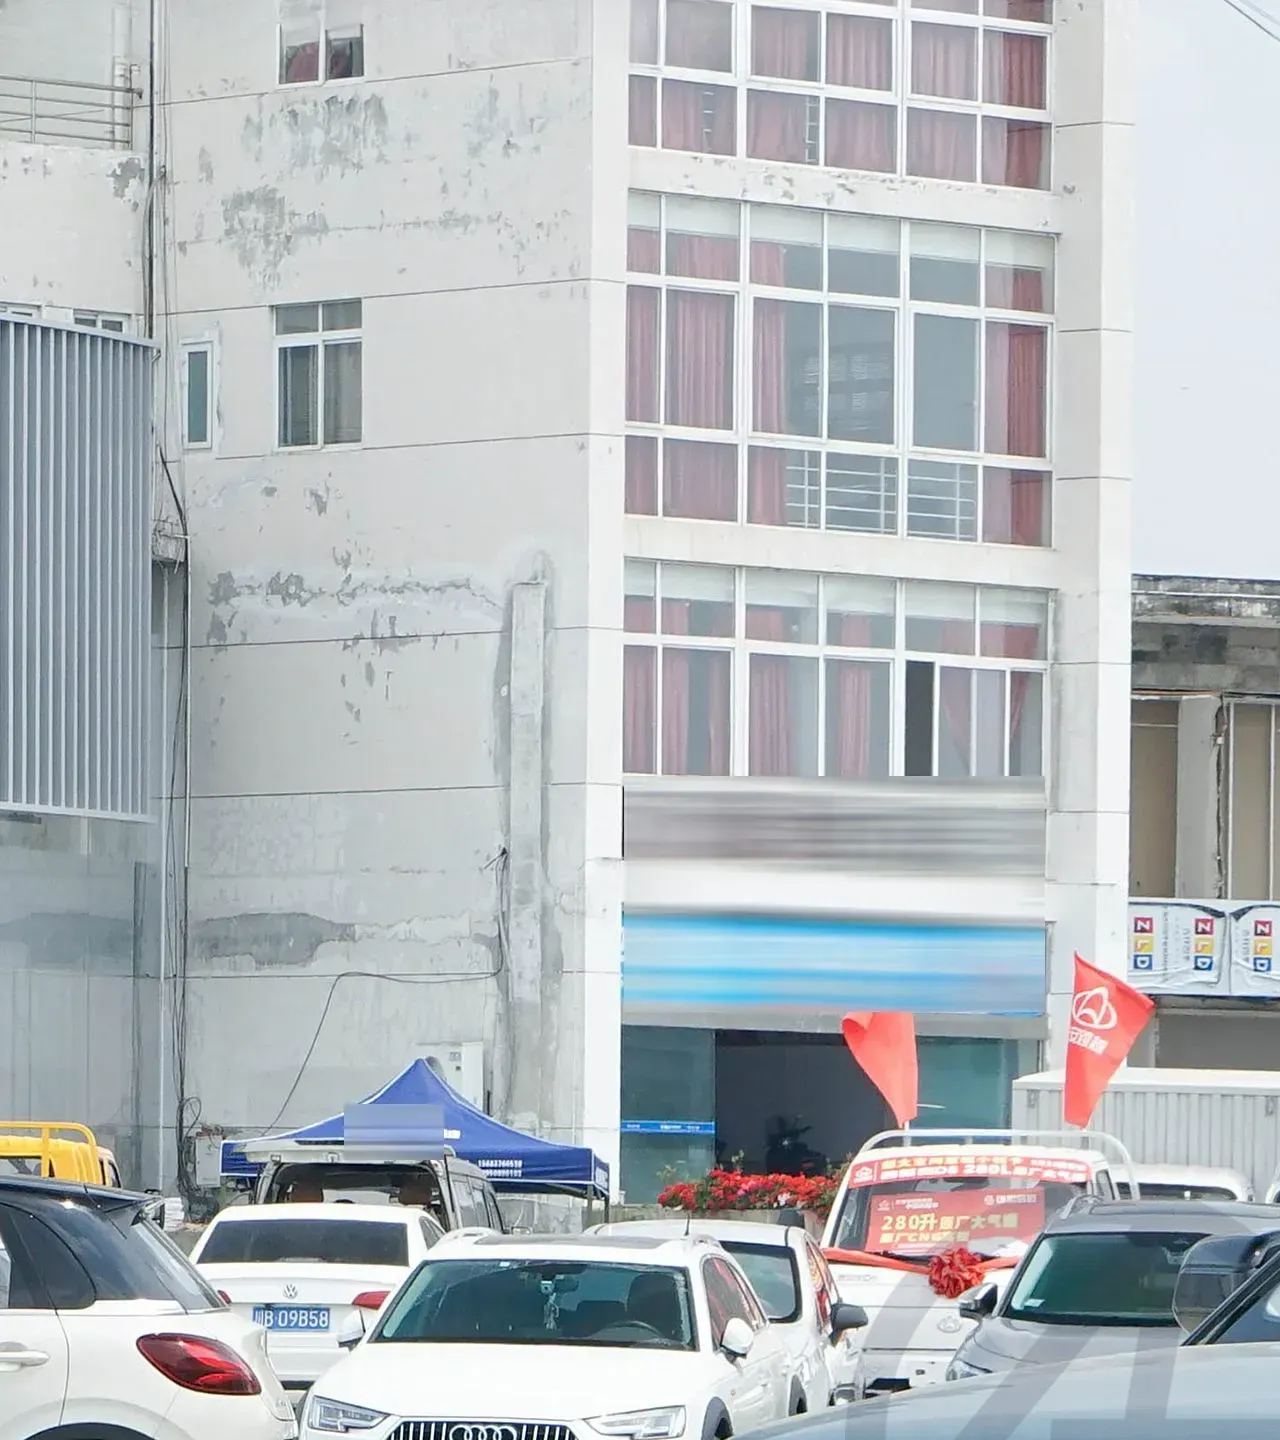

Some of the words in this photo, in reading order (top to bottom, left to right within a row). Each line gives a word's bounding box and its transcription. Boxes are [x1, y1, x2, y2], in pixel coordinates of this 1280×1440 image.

[1135, 918, 1151, 968] ZLD
[1196, 920, 1213, 969] ZLD
[1255, 922, 1271, 970] ZLD
